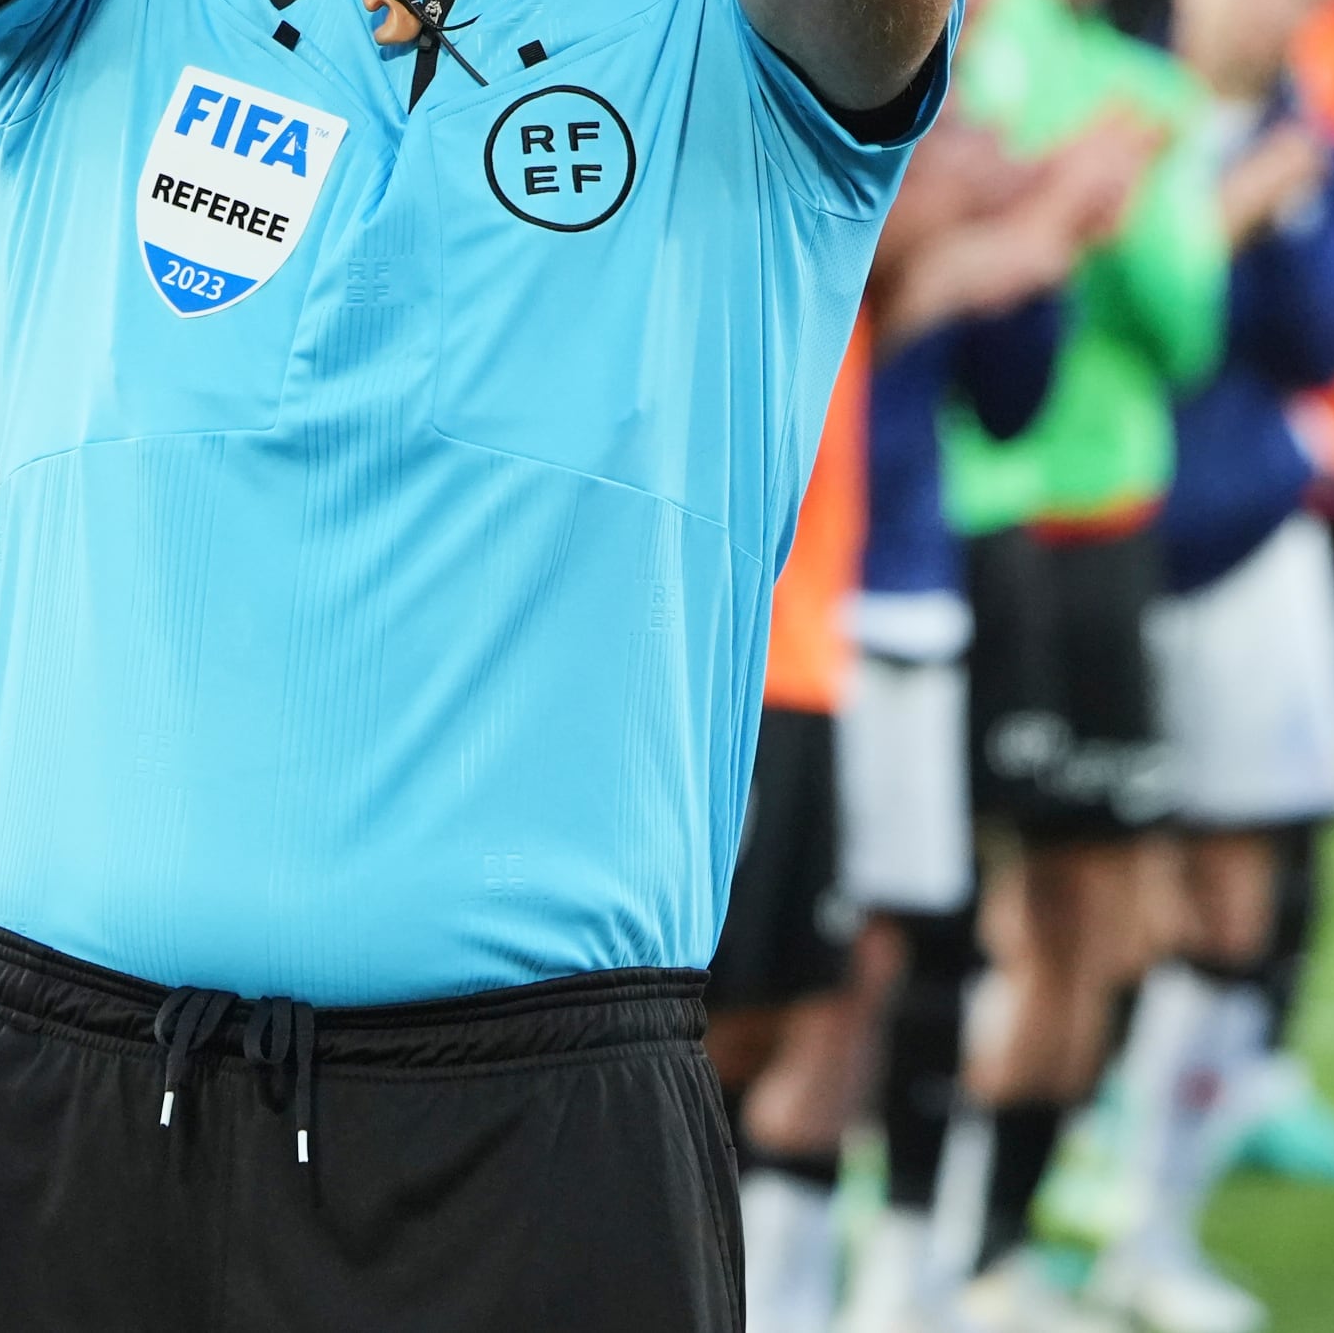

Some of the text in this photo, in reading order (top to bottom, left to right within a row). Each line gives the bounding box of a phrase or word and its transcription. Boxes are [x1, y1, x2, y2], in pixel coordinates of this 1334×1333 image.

[173, 84, 310, 179] FIFA
[151, 172, 290, 243] REFEREE
[161, 260, 227, 300] 2023
